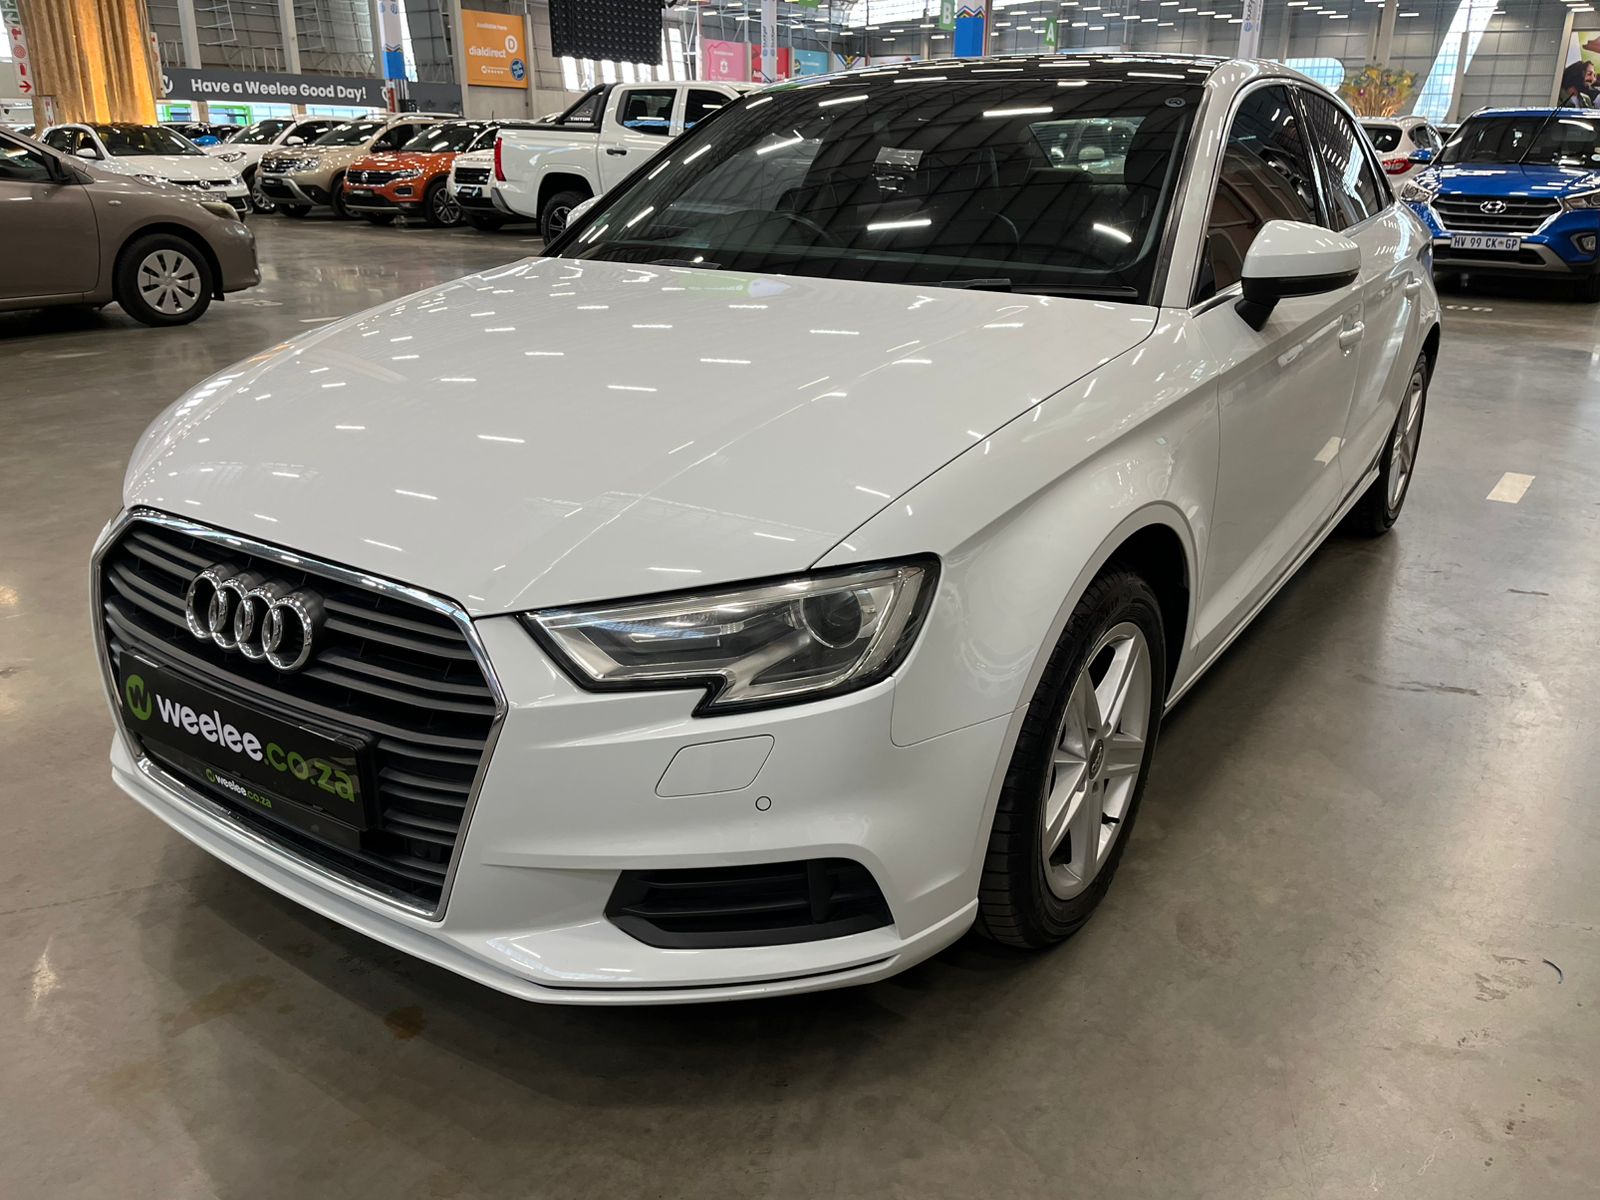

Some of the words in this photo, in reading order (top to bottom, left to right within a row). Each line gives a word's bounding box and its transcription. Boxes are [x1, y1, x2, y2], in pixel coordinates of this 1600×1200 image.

[942, 2, 952, 25] B
[1046, 21, 1055, 42] A
[468, 46, 506, 58] dialdirect
[191, 78, 230, 93] Have
[233, 82, 243, 94] a
[245, 81, 297, 96] Weelee
[300, 83, 335, 98] Good
[337, 85, 367, 102] Day!
[1454, 236, 1467, 247] HV
[1470, 237, 1482, 247] 99
[1485, 238, 1497, 248] CK
[1505, 239, 1518, 249] GP
[156, 693, 355, 802] weelee.co.za
[215, 774, 273, 809] weelee.co.za
